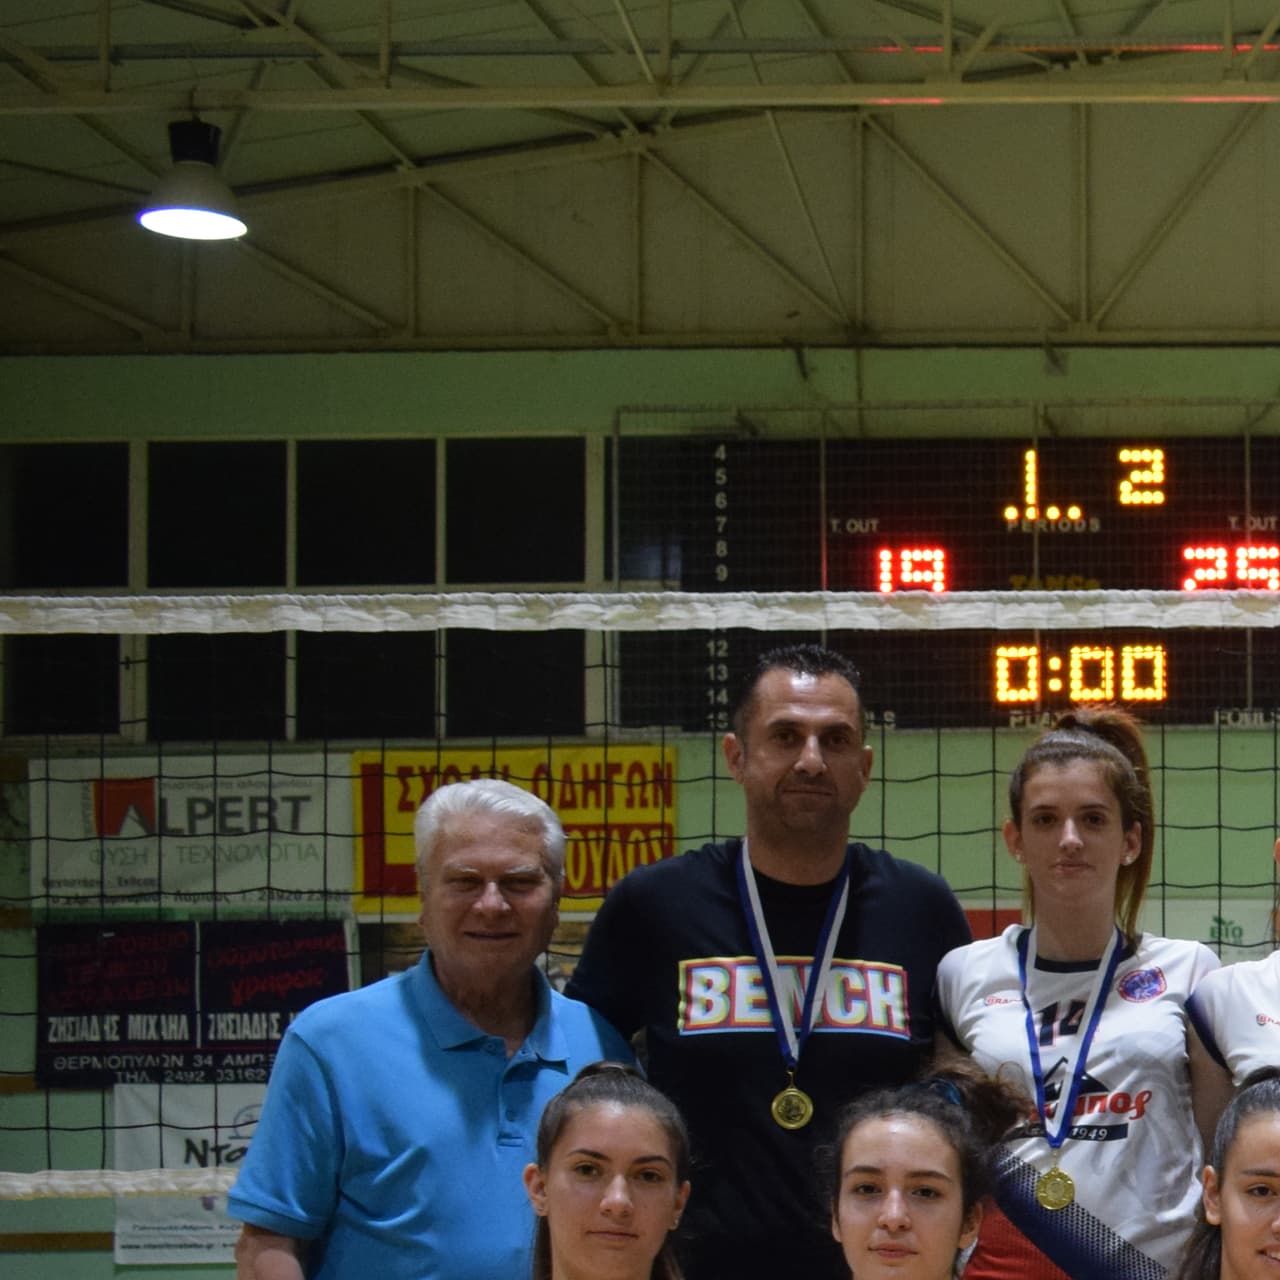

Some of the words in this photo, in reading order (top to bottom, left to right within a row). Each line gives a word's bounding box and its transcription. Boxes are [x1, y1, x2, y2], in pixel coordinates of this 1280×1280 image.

[714, 445, 727, 461] 4
[714, 468, 728, 485] 5
[1118, 448, 1165, 505] 2
[714, 492, 728, 509] 6
[714, 518, 728, 533] 7
[847, 519, 880, 533] OUT
[1008, 518, 1101, 533] PERIODS
[714, 541, 728, 558] 8
[714, 566, 728, 582] 9
[879, 548, 945, 593] 19
[1184, 546, 1280, 590] 25
[995, 645, 1166, 702] 0:00
[532, 762, 673, 809] ΟΔΗΓΩΝ
[177, 843, 320, 865] ΤΕΧΝΟΛΟΓΙΑ
[688, 963, 904, 1029] BENCH
[1071, 1126, 1108, 1140] 1949
